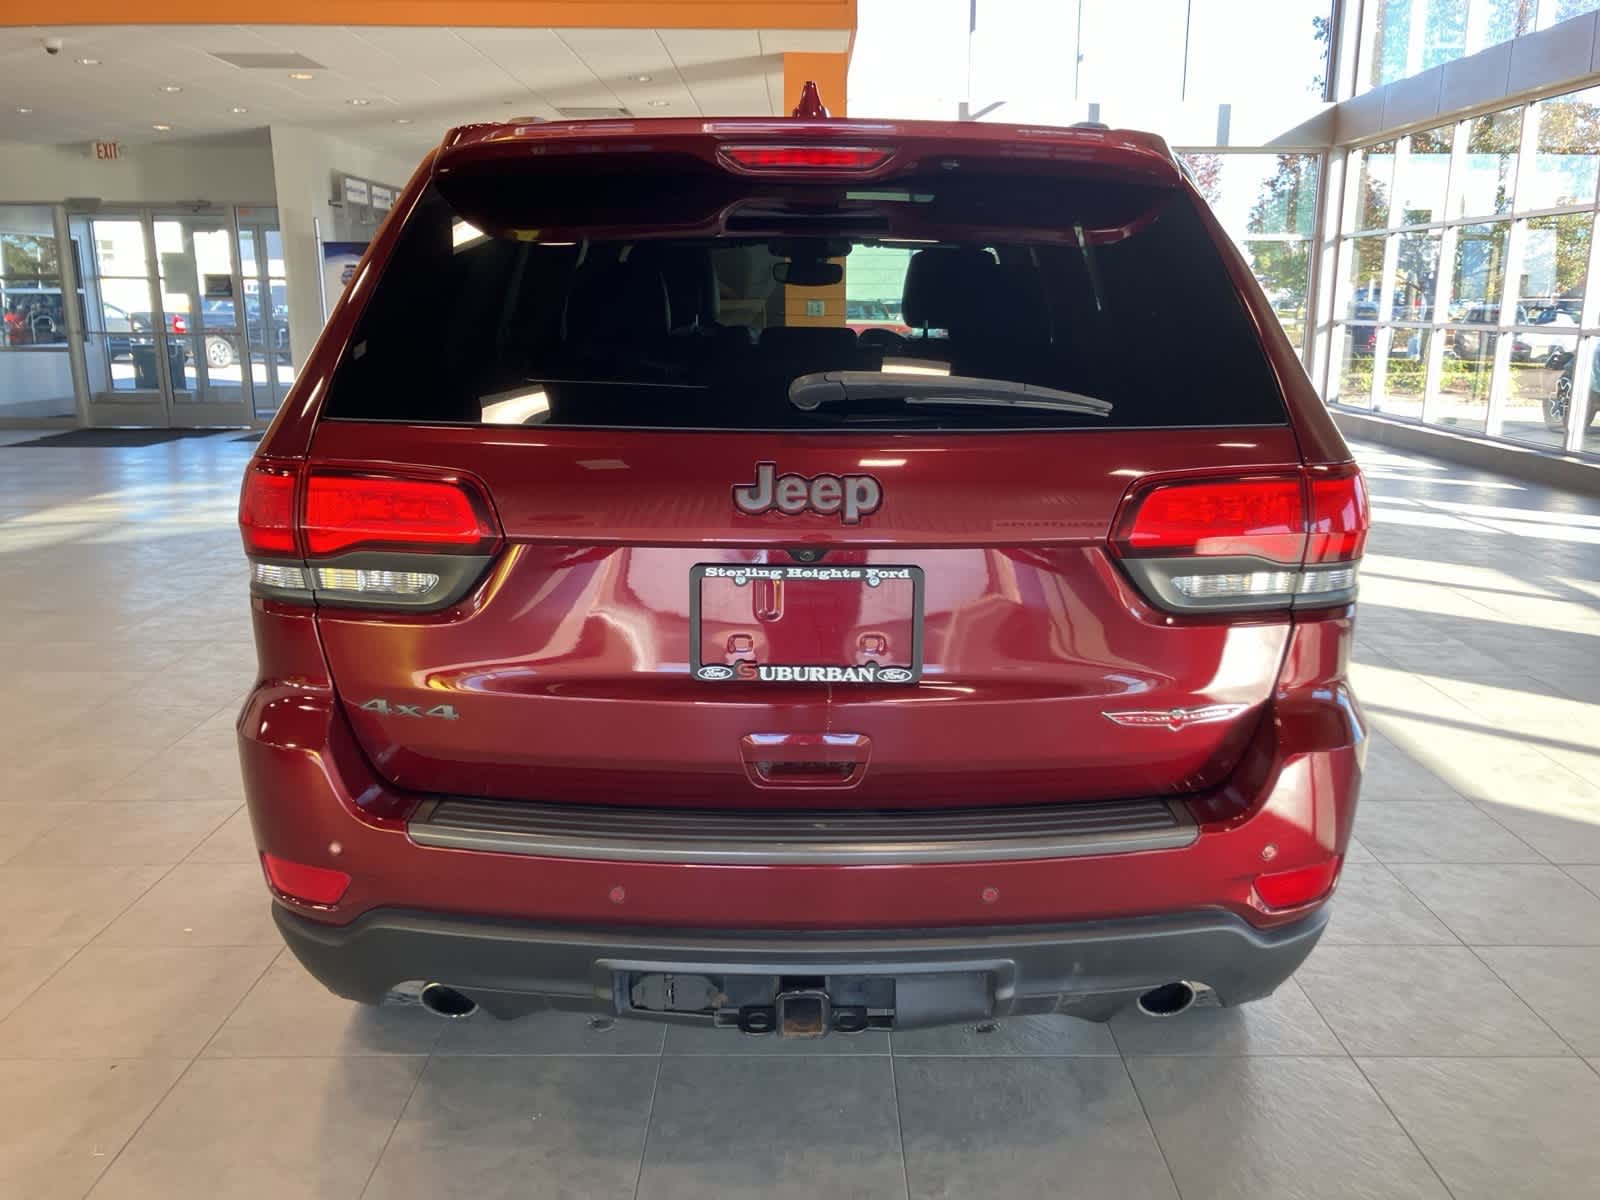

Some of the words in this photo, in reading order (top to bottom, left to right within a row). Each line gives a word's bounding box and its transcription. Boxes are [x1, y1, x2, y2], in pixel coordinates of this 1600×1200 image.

[96, 142, 117, 160] EXIT
[732, 461, 882, 524] Jeep
[705, 567, 783, 580] Sterling
[787, 568, 861, 580] Heights
[866, 568, 910, 580] Ford
[738, 662, 874, 682] SUBURBAN
[360, 698, 459, 720] 4x4
